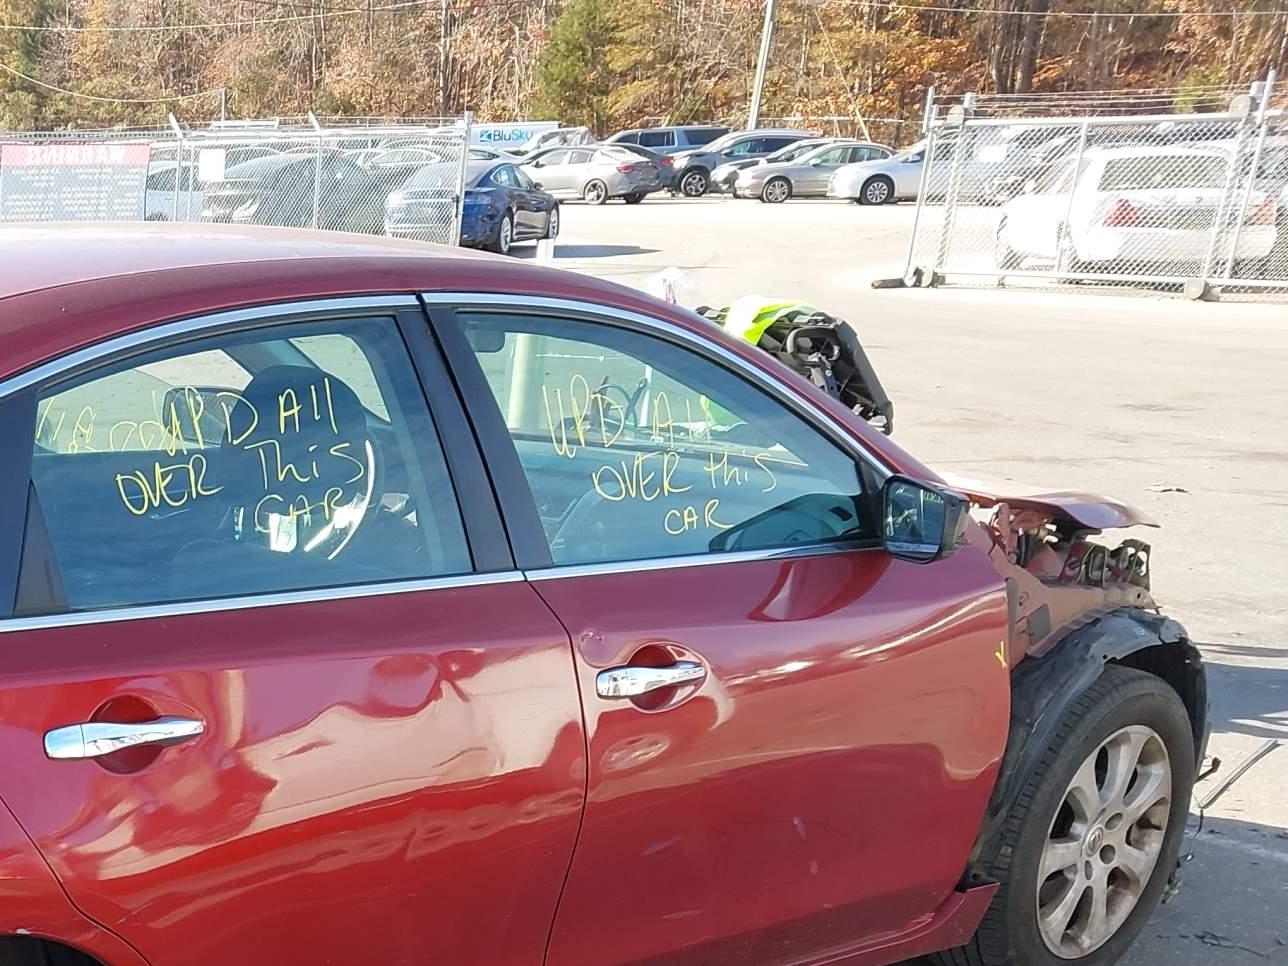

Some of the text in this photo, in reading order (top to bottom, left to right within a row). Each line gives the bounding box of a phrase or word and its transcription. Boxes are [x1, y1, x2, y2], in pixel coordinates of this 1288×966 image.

[115, 453, 225, 516] OVER
[592, 450, 694, 501] OVER
[664, 499, 736, 535] CAR
